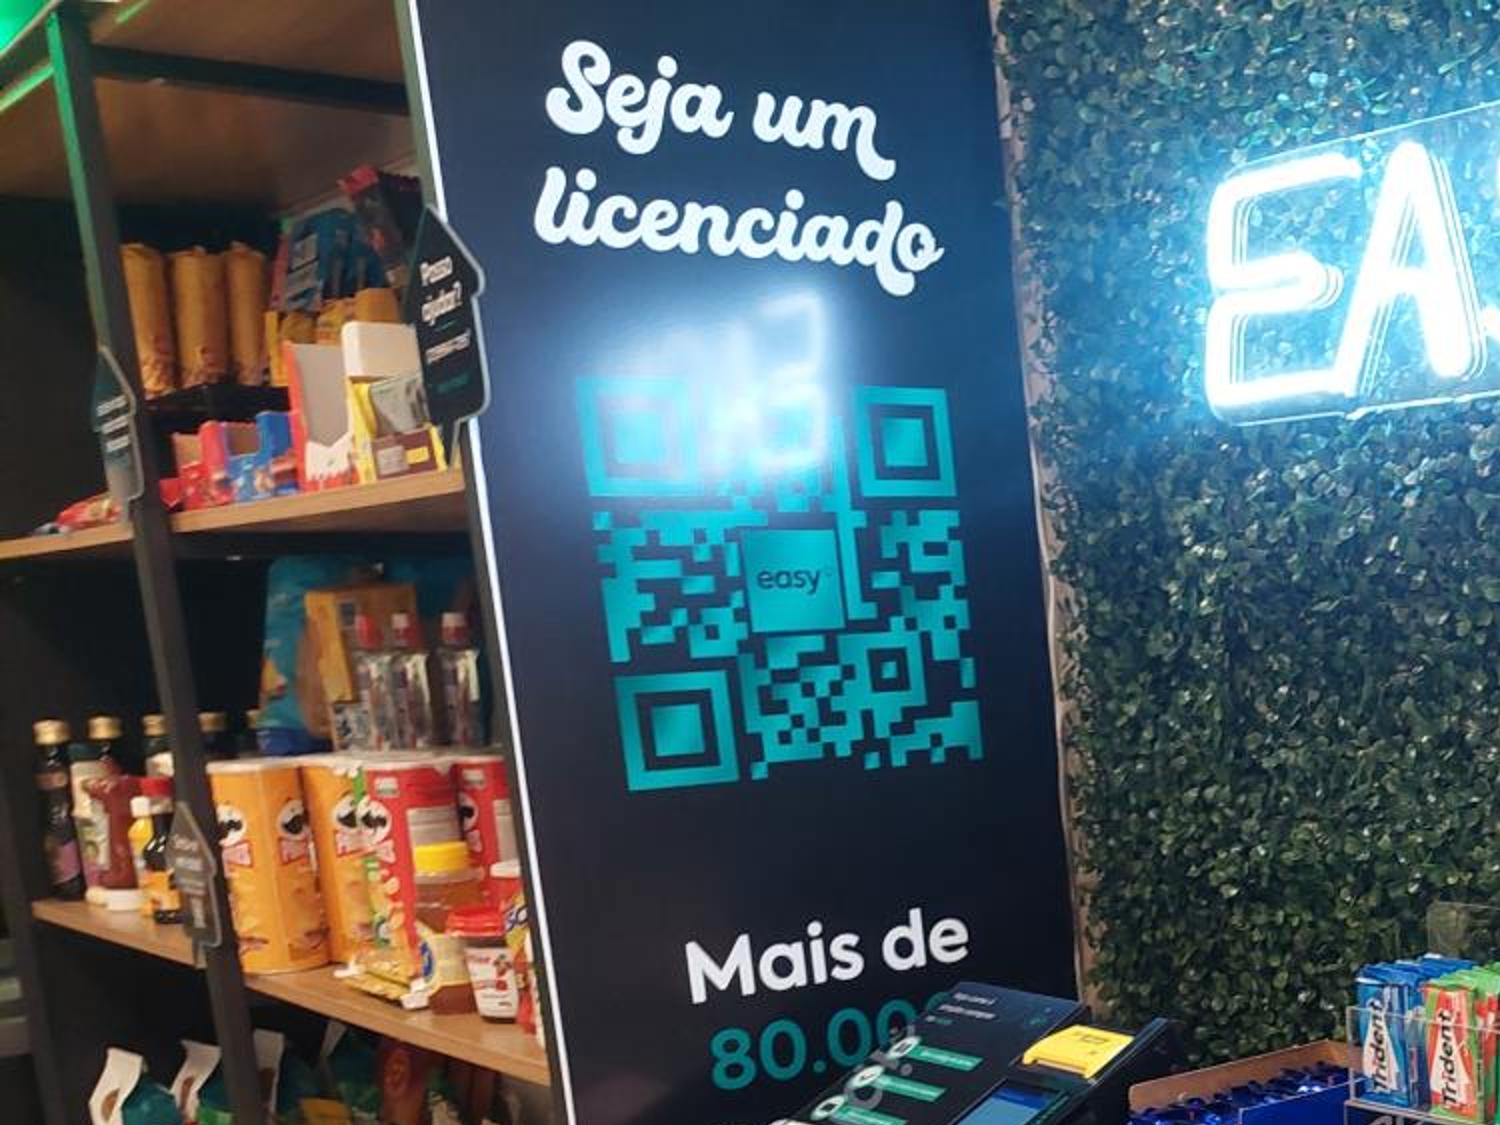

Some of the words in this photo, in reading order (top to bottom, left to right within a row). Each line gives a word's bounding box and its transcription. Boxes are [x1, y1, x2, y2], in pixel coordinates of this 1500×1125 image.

[545, 40, 733, 155] Seja
[752, 91, 897, 181] um
[534, 166, 945, 296] licenciado
[757, 567, 822, 594] easy
[685, 922, 864, 1005] Mais
[882, 907, 969, 971] de
[709, 990, 950, 1091] 80.00
[1367, 998, 1390, 1093] Trident
[1437, 1008, 1459, 1109] Trident
